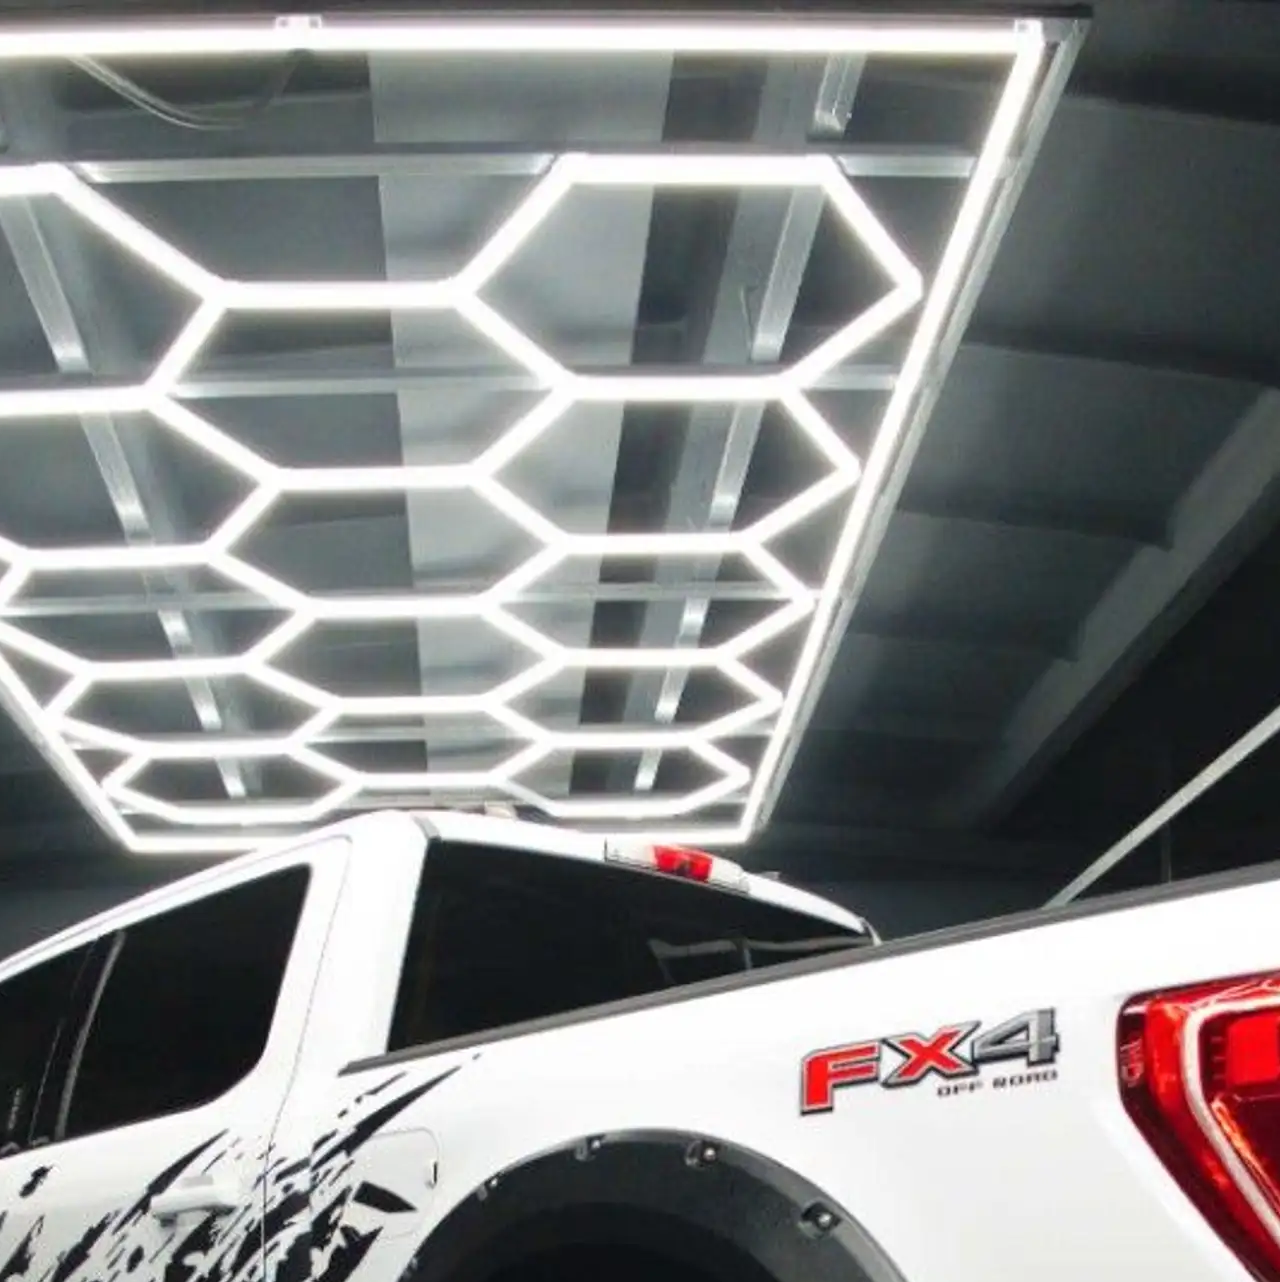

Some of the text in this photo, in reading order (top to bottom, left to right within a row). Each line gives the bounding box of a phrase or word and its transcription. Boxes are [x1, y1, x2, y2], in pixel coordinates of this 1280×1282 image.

[800, 1007, 1060, 1116] FX4
[936, 1069, 1059, 1099] OFF ROAD
